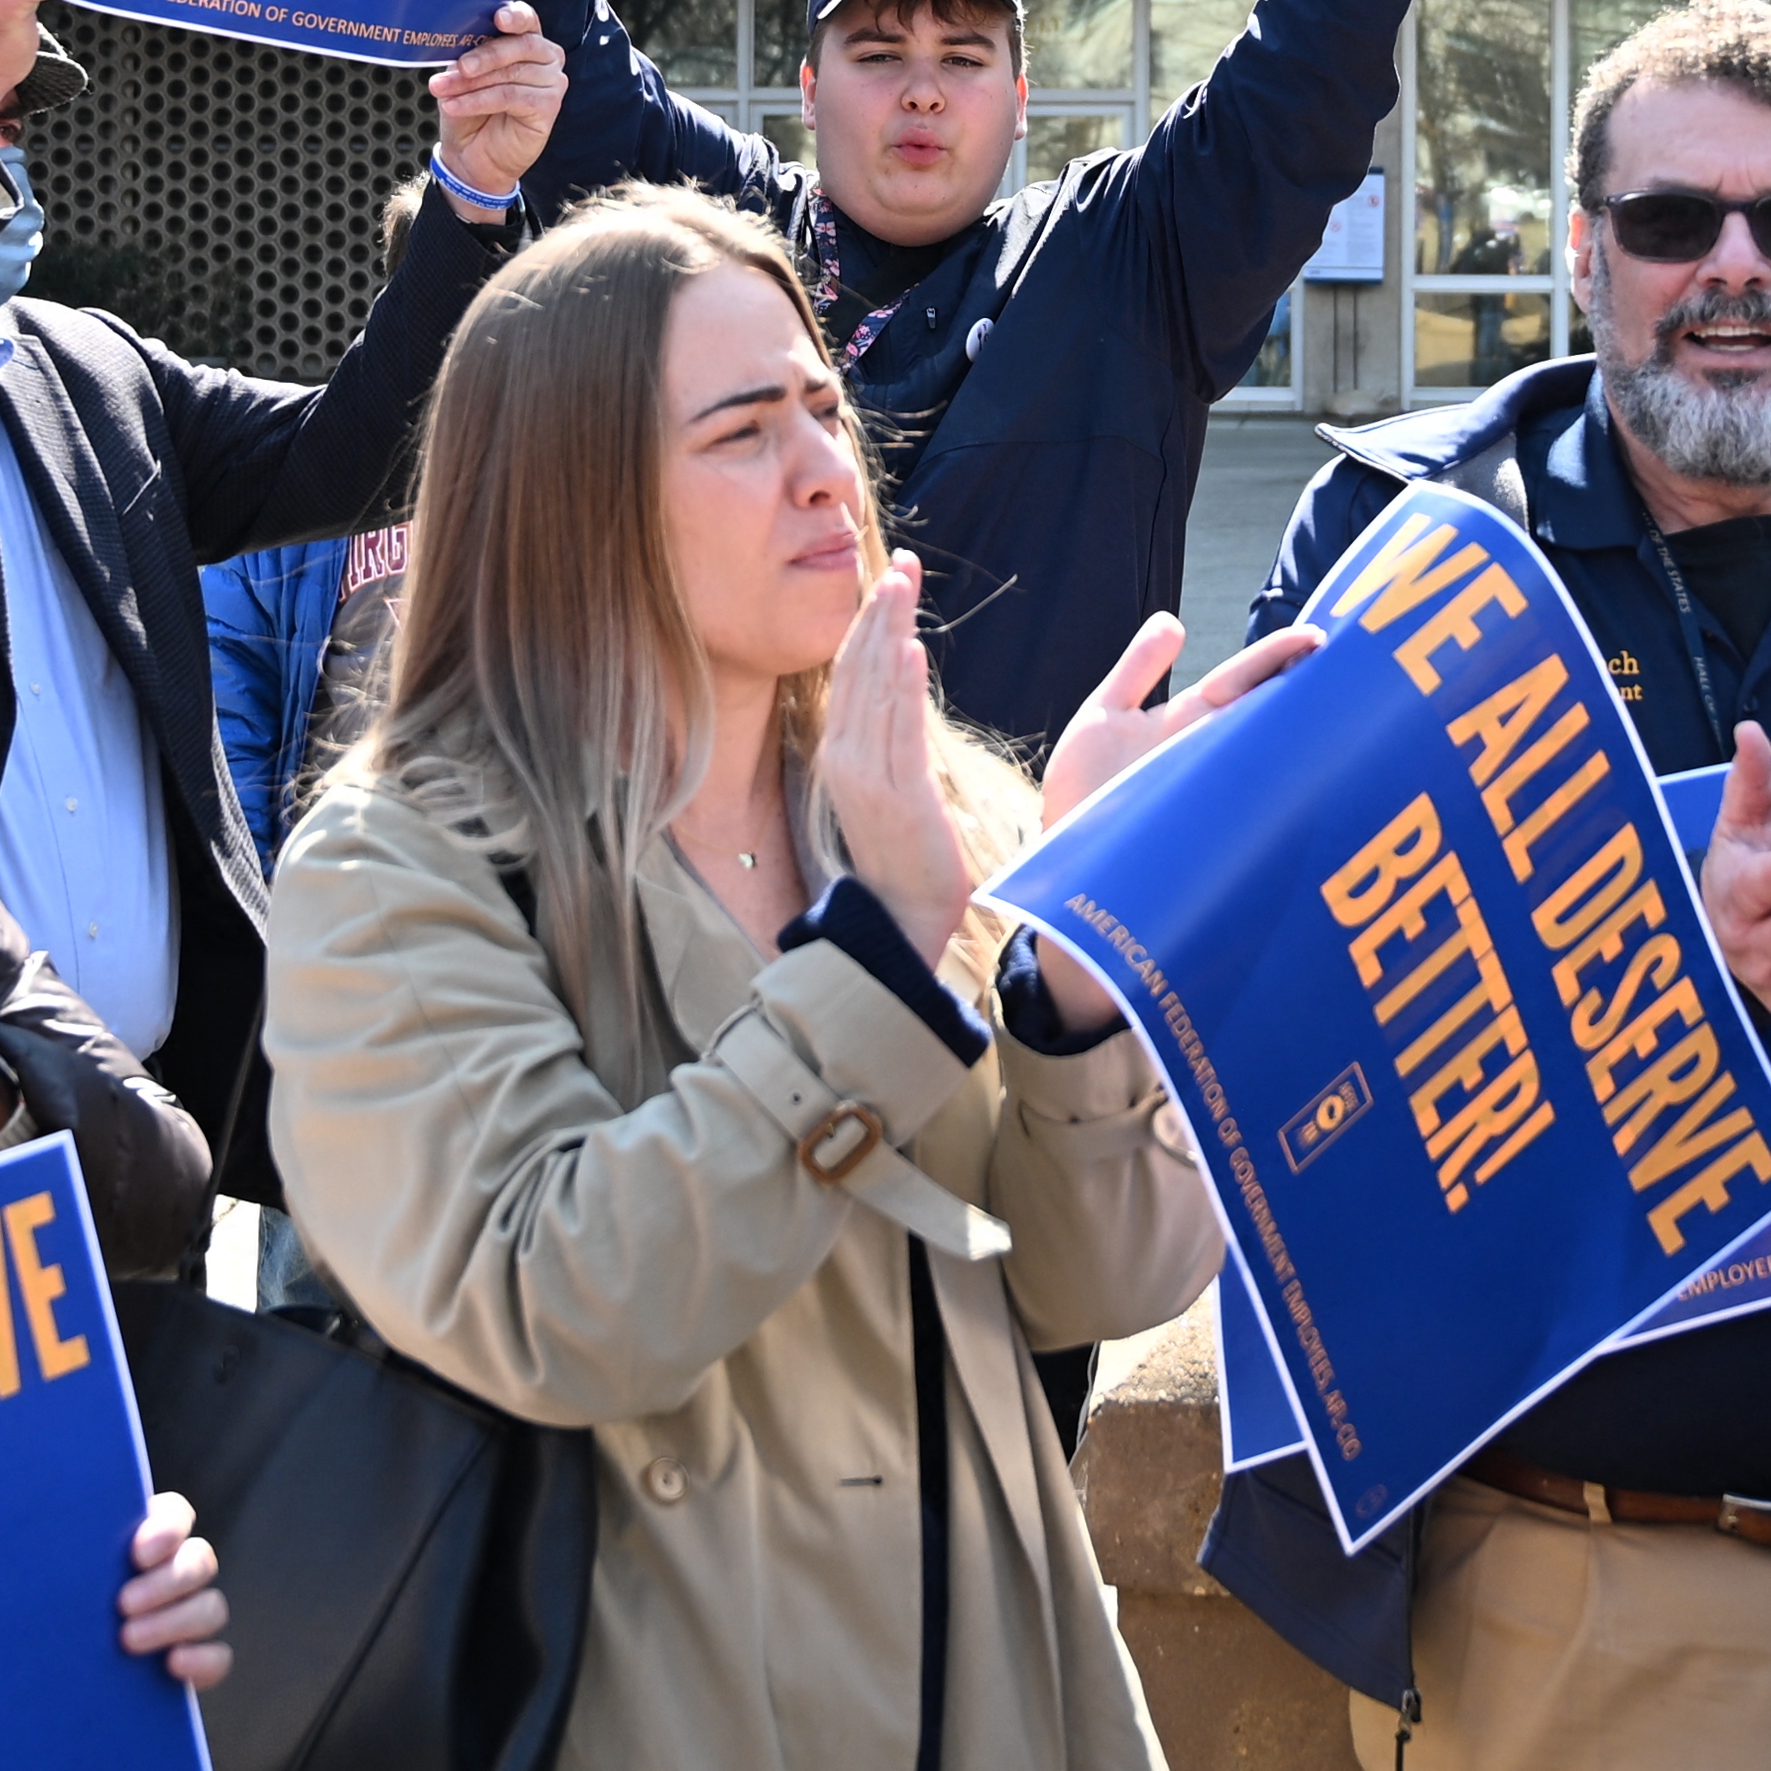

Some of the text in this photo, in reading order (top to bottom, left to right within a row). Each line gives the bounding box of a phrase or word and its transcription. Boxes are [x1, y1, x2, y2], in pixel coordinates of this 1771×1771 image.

[265, 5, 289, 23] OF
[291, 10, 403, 44] GOVERNMENT
[1667, 568, 1692, 613] STATES
[1330, 510, 1528, 697] WE
[1446, 652, 1612, 884] ALL
[1063, 892, 1170, 997] AMERICAN
[1318, 791, 1555, 1215] BETTER!
[1157, 991, 1231, 1126] FEDERATION
[1217, 1117, 1244, 1149] OF
[1229, 1145, 1299, 1283] GOVERNMENT
